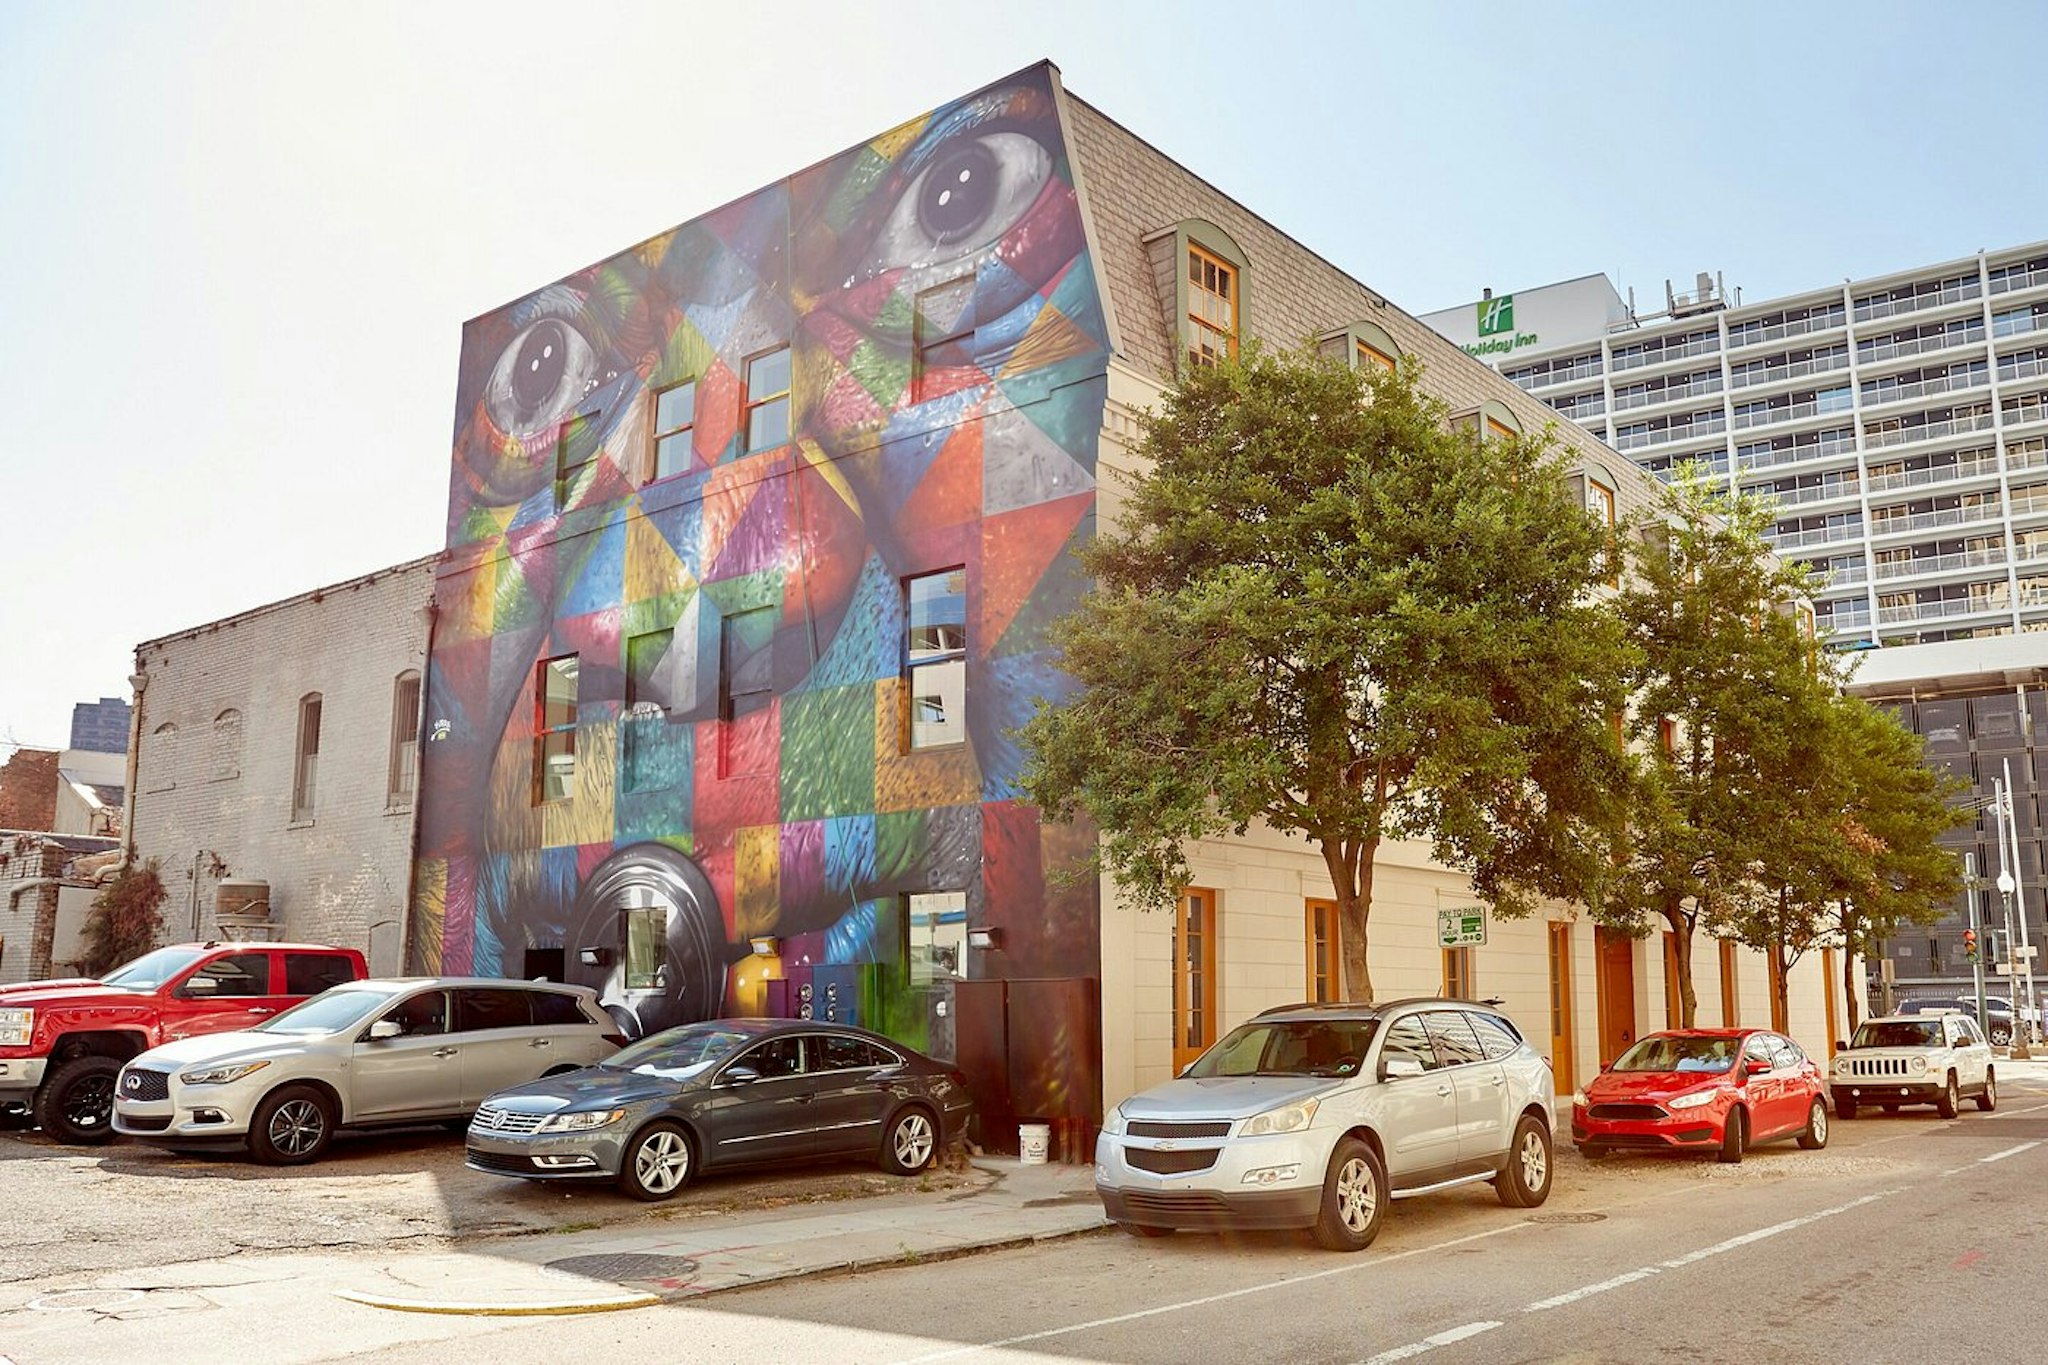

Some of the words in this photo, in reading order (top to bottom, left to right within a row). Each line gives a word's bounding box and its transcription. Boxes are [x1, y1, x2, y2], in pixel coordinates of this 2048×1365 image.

[1515, 333, 1537, 348] Inn
[1439, 910, 1451, 918] PAY
[1453, 909, 1461, 917] TO
[1463, 907, 1482, 916] PARK
[1447, 919, 1452, 929] 2
